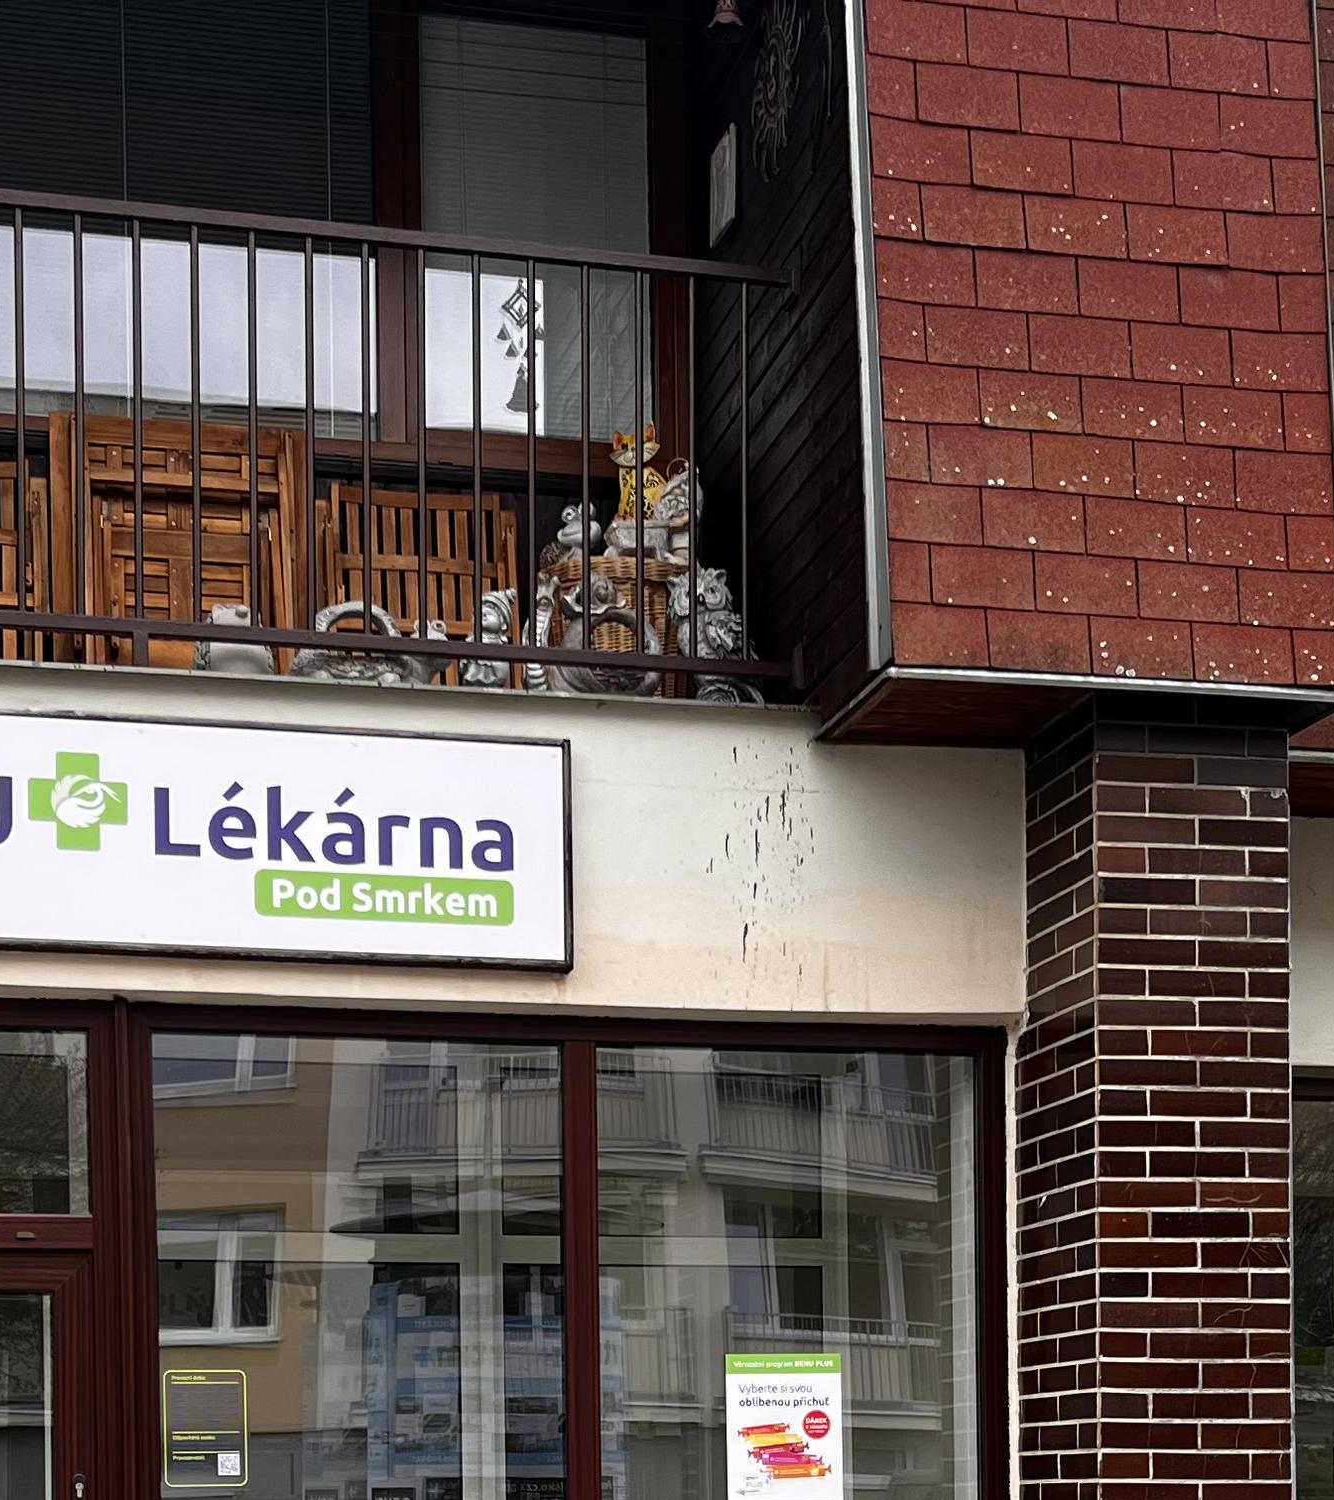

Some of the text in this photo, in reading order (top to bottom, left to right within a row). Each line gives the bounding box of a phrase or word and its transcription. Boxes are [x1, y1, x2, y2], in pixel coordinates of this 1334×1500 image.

[153, 781, 515, 872] Lékárna
[272, 879, 498, 918] Pod Smrkem
[738, 1383, 813, 1395] Vyberte si svou
[738, 1396, 830, 1408] oblíbenou příchuť
